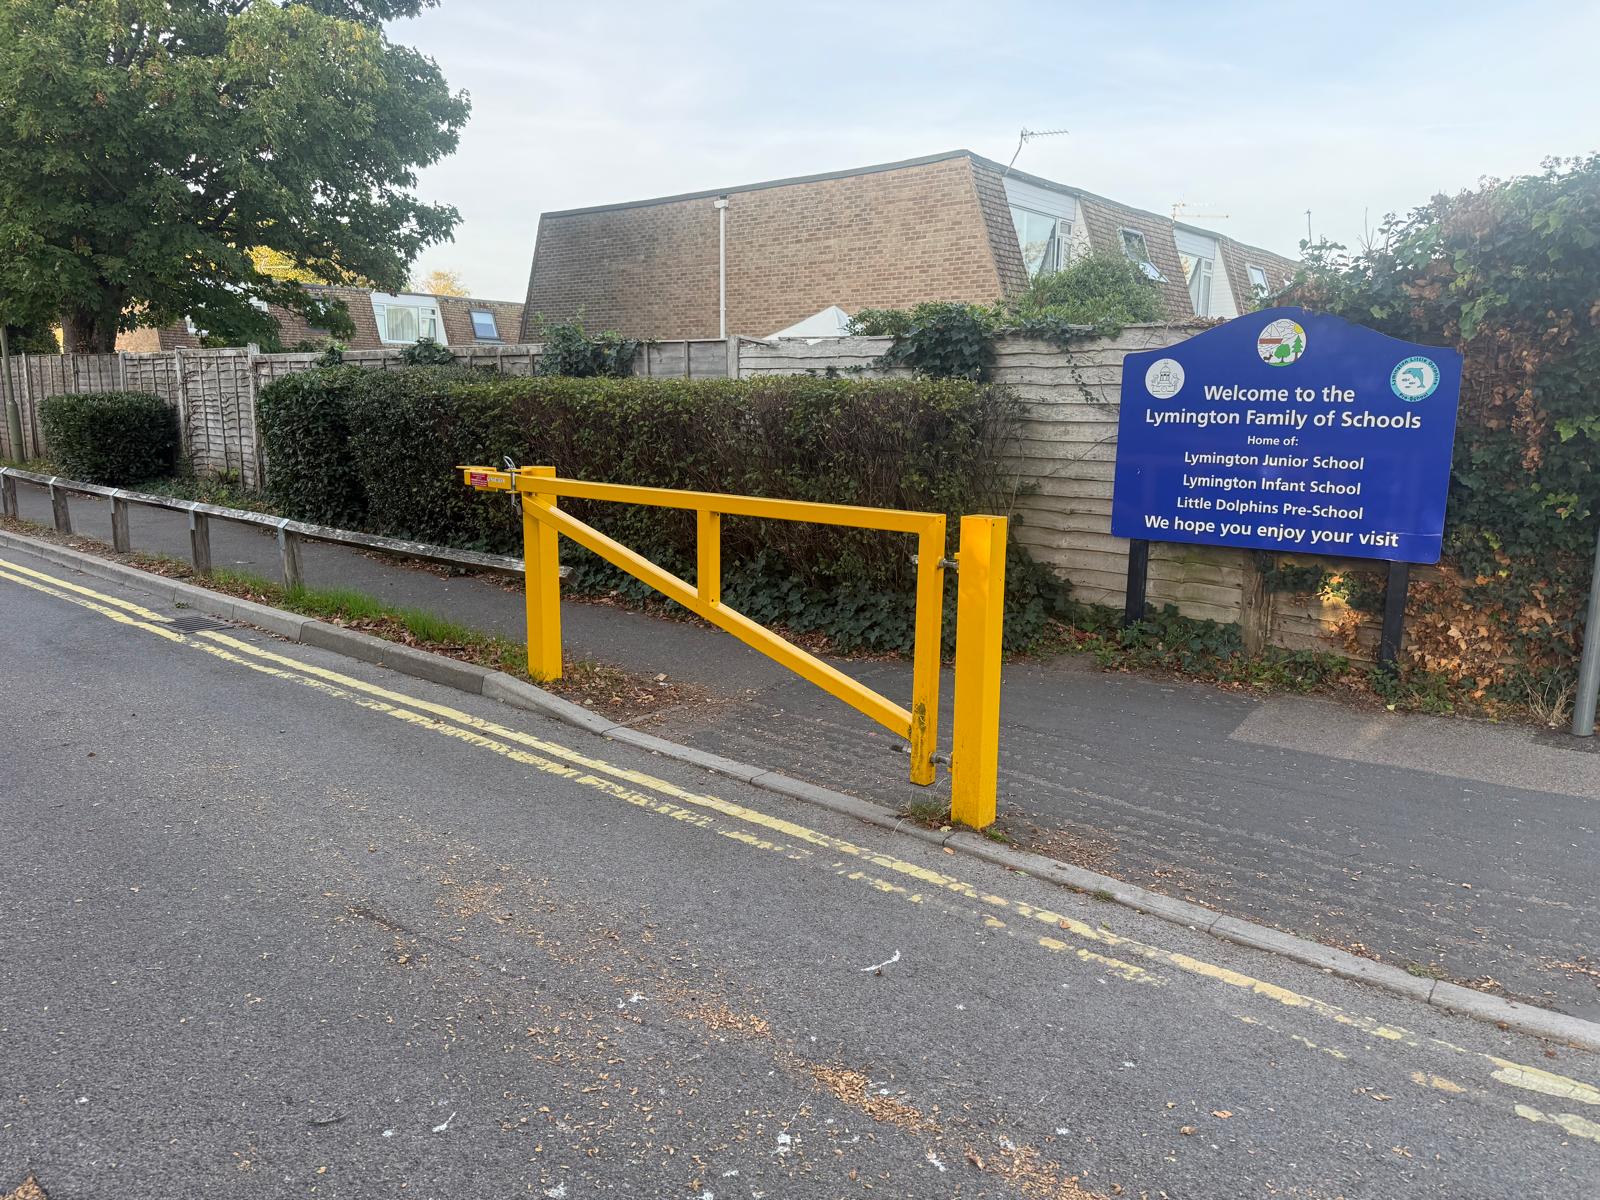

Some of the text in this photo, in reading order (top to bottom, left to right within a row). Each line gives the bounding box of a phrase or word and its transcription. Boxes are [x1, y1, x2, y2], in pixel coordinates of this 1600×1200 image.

[1204, 384, 1354, 403] Welcome to the
[1145, 408, 1420, 430] Lymington Family of Schools
[1247, 435, 1298, 446] Home of:
[1184, 451, 1364, 470] Lymington Junior School
[1183, 473, 1360, 495] Lymington Infant School
[1177, 496, 1363, 520] Little Dolphins Pre-School
[1144, 514, 1399, 548] We hope you enjoy your visit
